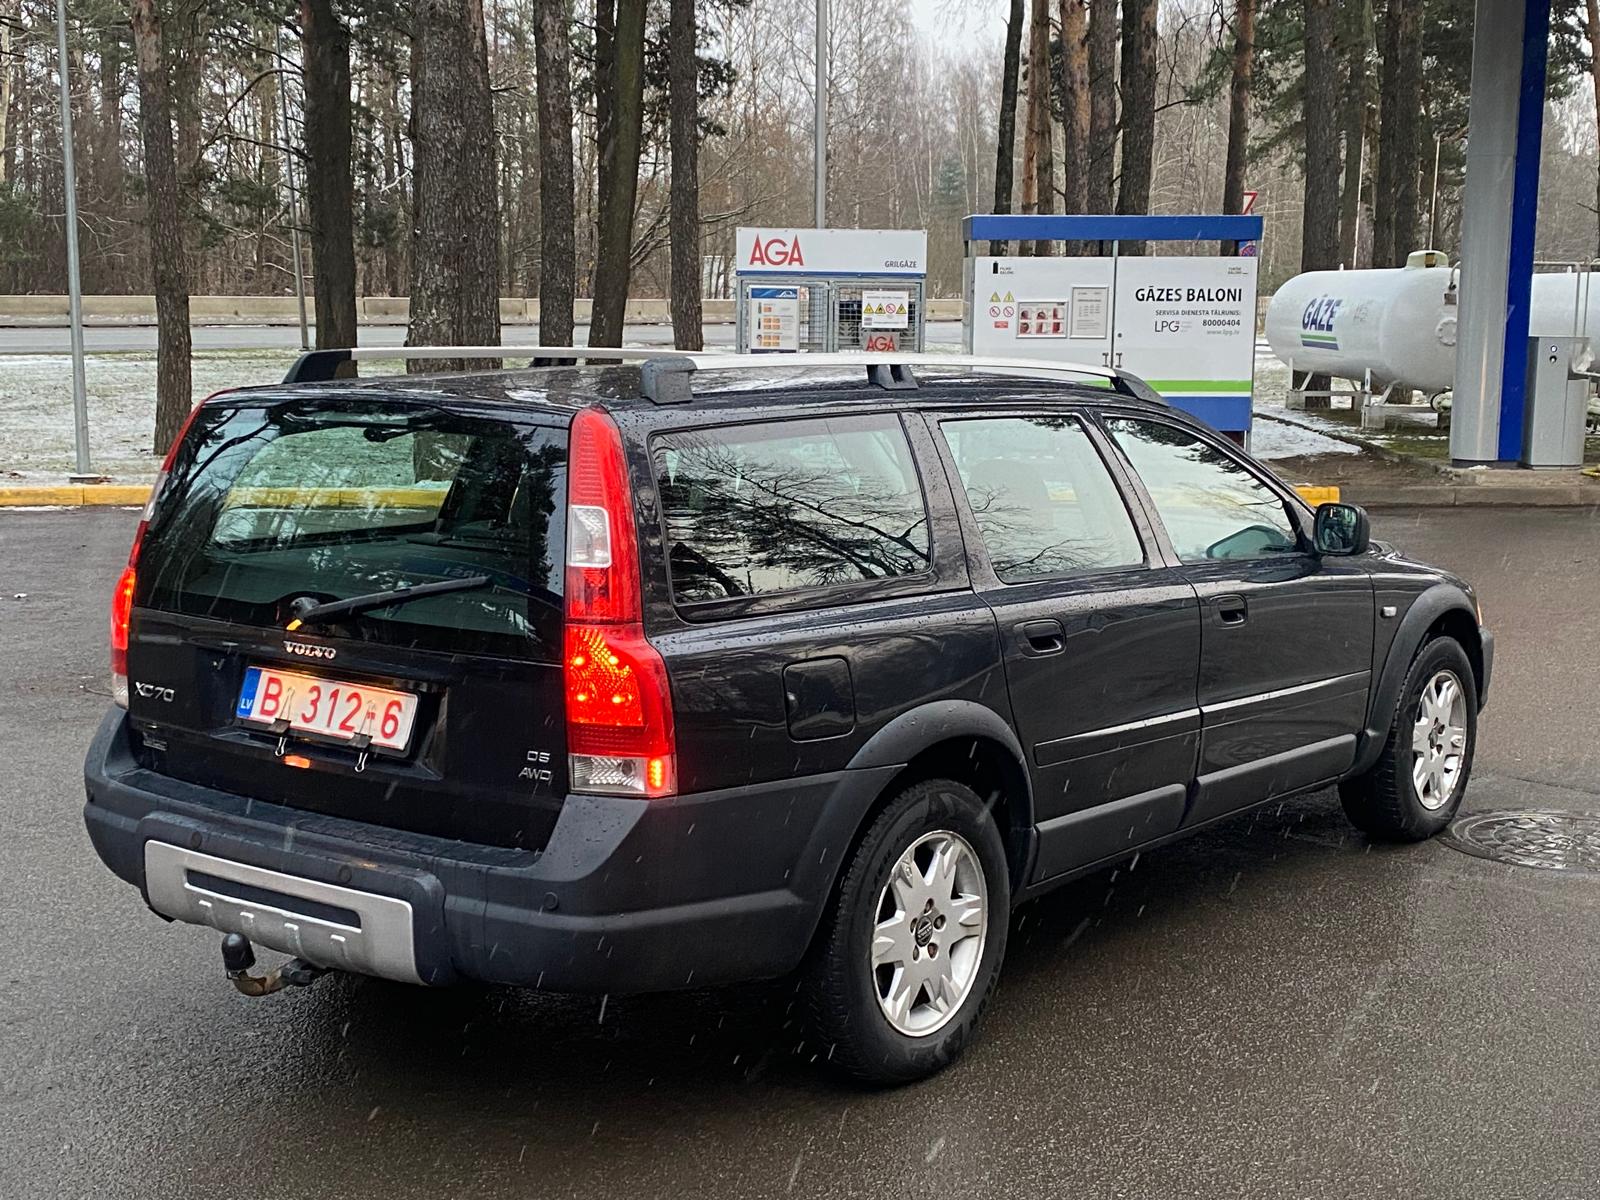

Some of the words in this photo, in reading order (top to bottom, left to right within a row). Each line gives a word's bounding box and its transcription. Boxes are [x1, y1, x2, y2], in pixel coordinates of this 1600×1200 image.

[749, 233, 804, 266] AGA
[1135, 285, 1182, 302] GĀZES
[1186, 288, 1242, 302] BALONI
[1302, 294, 1343, 332] GĀZE
[1154, 320, 1180, 333] LPG
[1202, 319, 1241, 327] 80000404
[866, 335, 897, 352] AGA
[283, 640, 337, 659] VOLVO
[134, 681, 175, 702] XC70
[259, 676, 284, 717] B
[240, 698, 253, 709] LV
[518, 766, 552, 780] AWD
